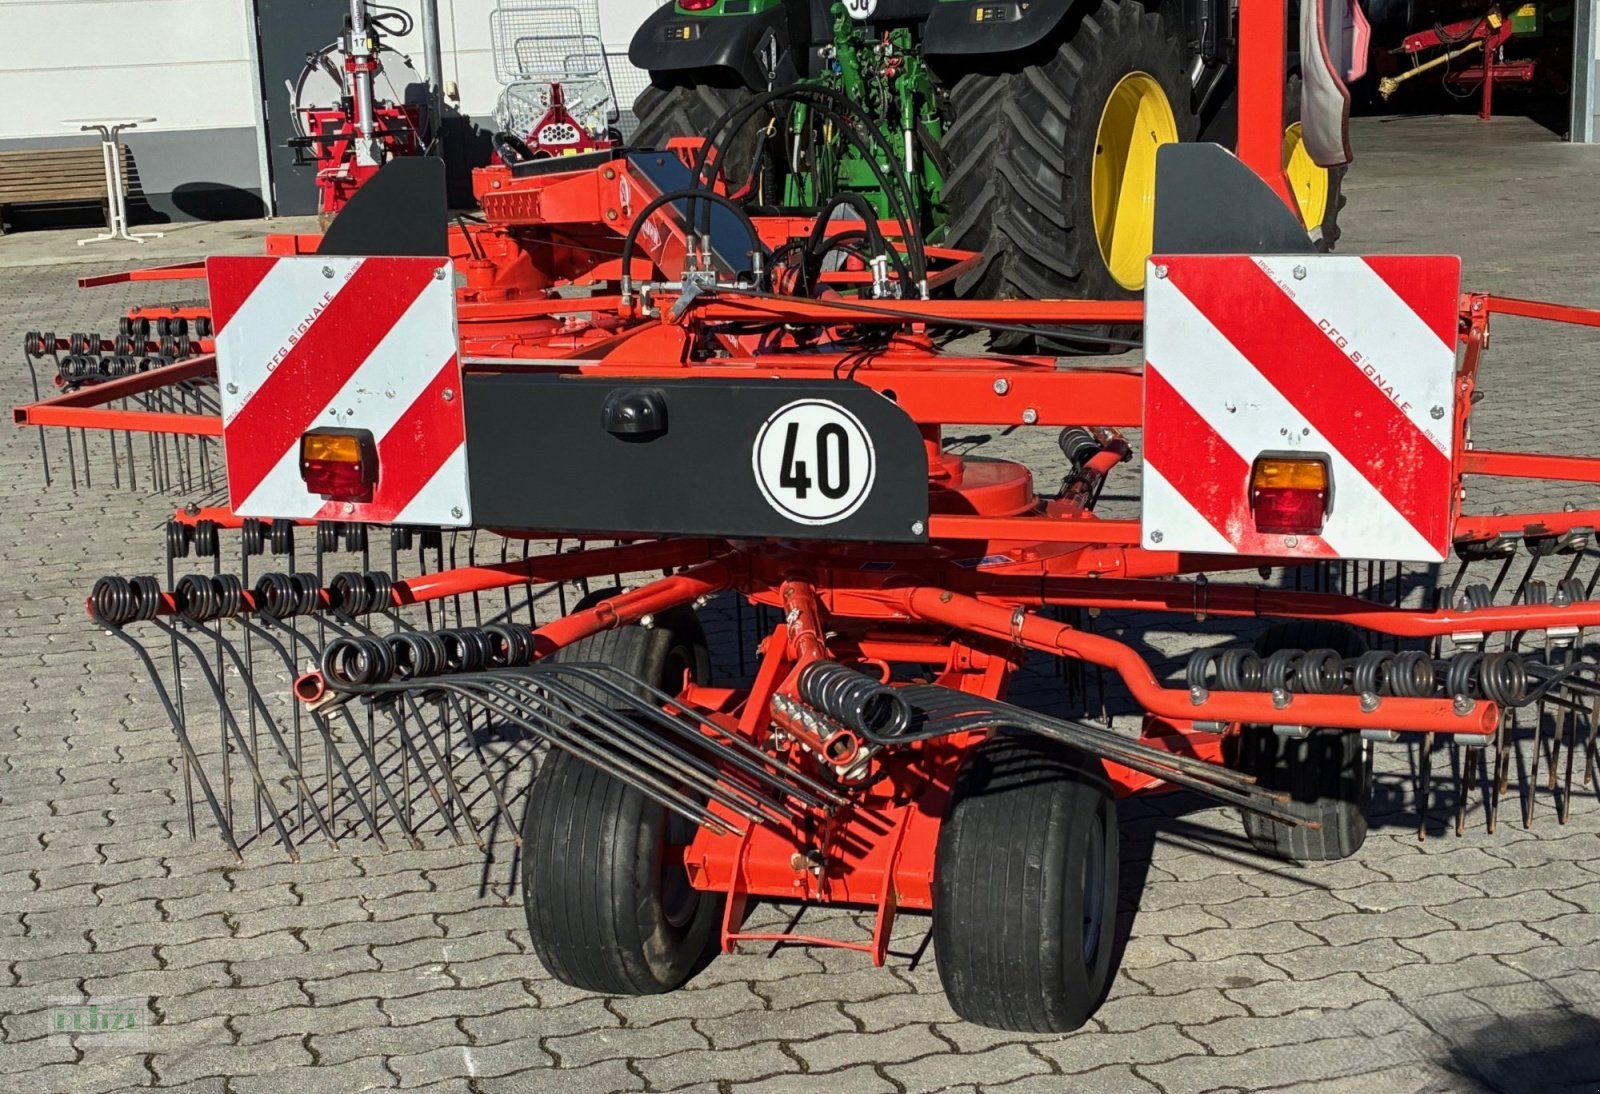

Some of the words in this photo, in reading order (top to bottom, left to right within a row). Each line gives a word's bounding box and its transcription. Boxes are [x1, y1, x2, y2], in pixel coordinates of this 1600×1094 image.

[354, 38, 365, 47] 17
[1318, 318, 1349, 349] CFG
[266, 346, 288, 372] CFG
[780, 422, 850, 500] 40
